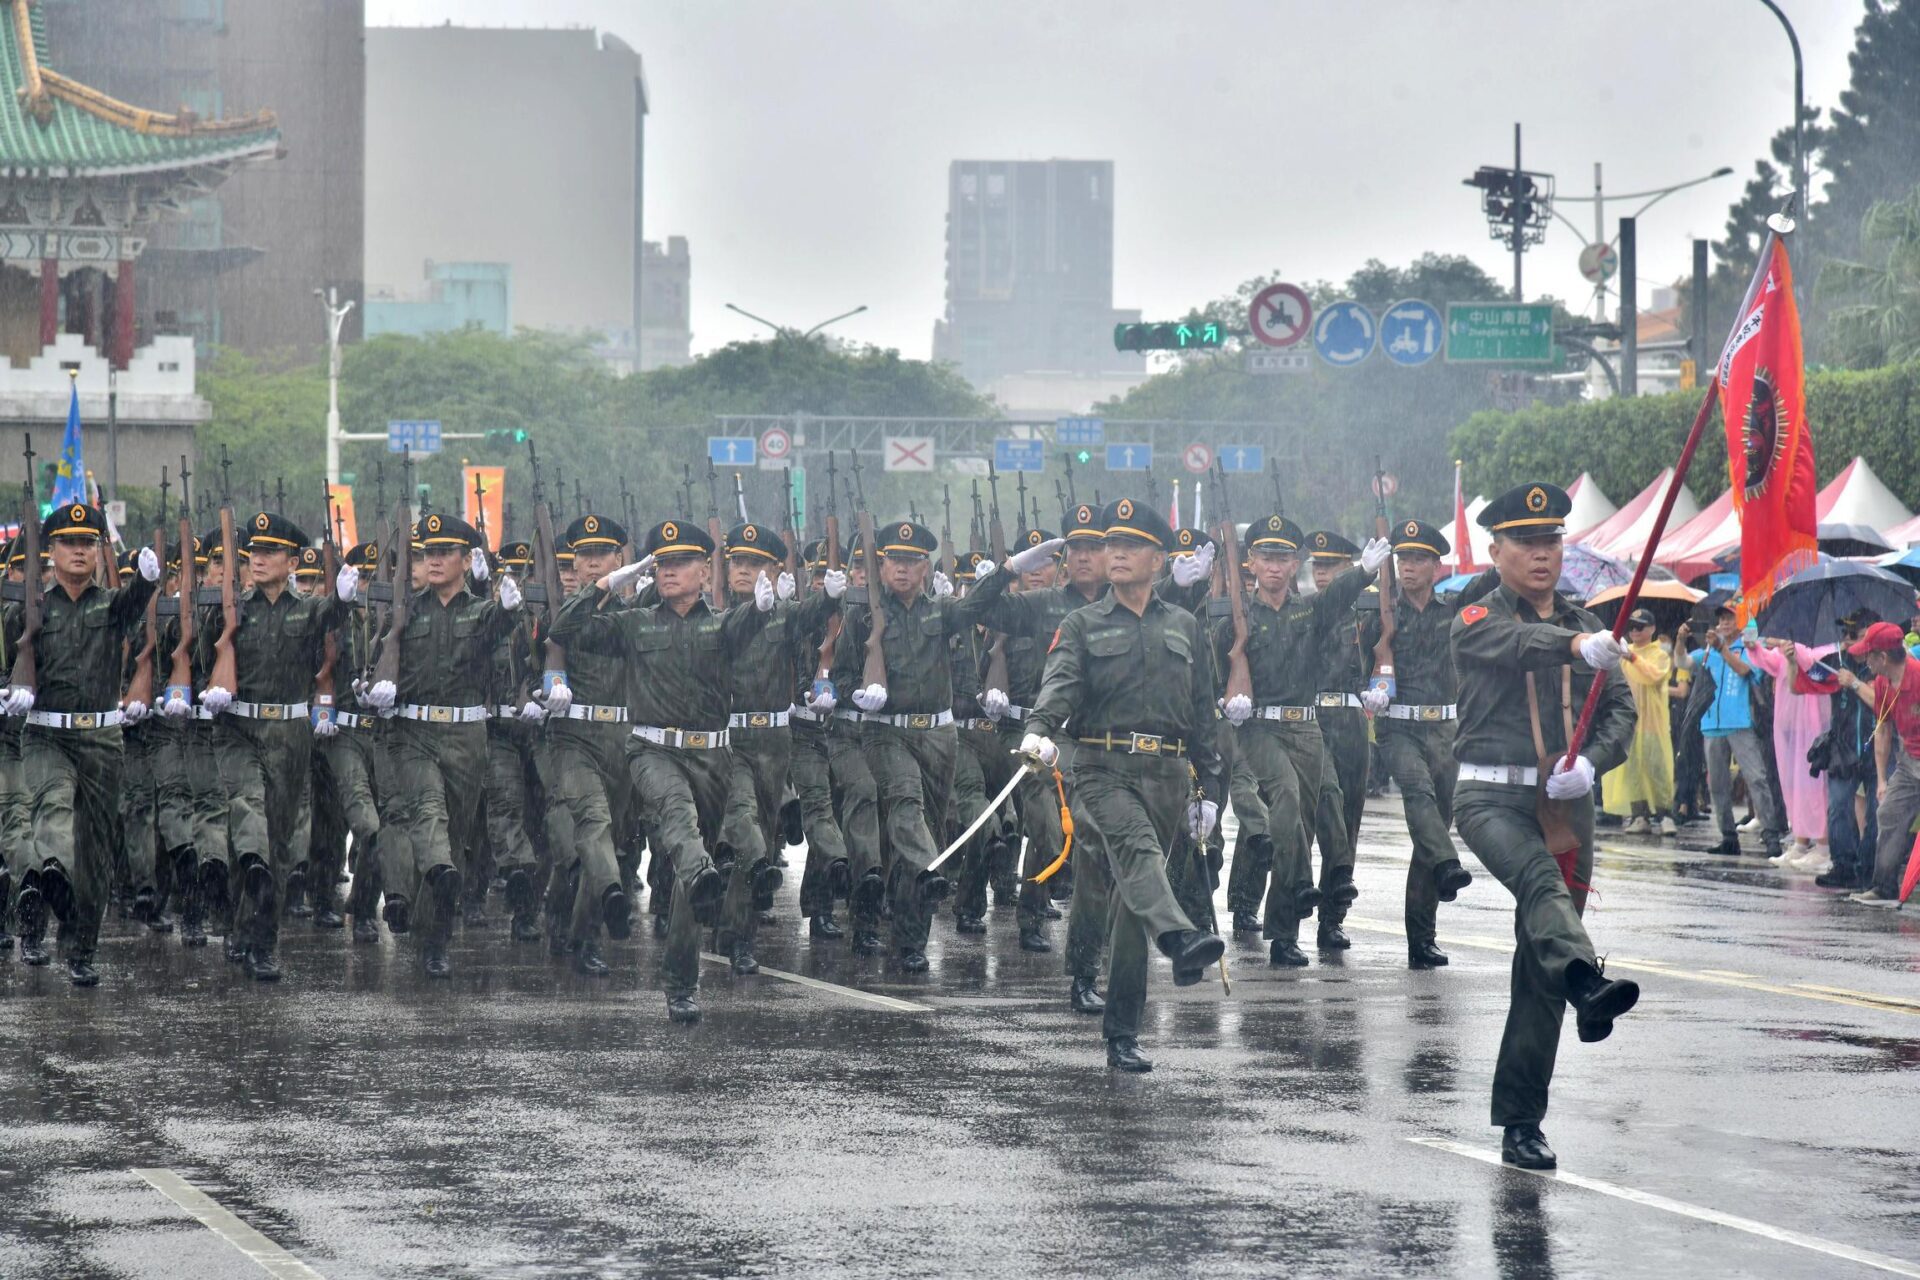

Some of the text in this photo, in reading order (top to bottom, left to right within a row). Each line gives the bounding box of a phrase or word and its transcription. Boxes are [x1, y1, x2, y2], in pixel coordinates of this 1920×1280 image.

[1469, 309, 1531, 325] 中山南路
[768, 440, 784, 449] 40
